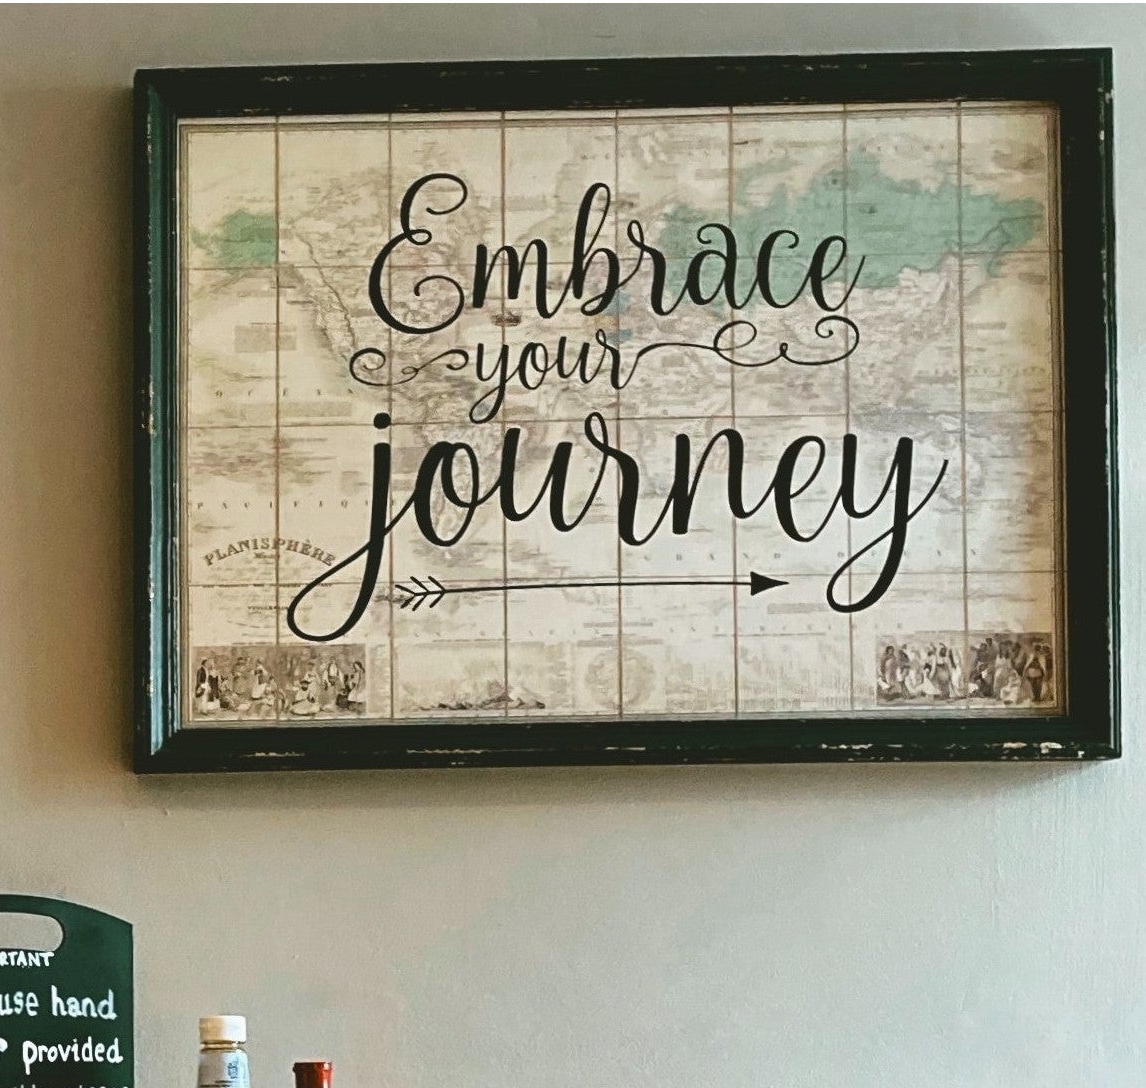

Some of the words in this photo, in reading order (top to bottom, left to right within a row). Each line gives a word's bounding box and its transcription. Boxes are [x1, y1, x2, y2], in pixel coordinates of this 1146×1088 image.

[367, 172, 866, 335] Embrace
[468, 329, 644, 424] your
[203, 537, 336, 567] PLANISPHÈRE
[286, 411, 949, 642] journey
[51, 984, 118, 1020] hand
[22, 1035, 124, 1075] provided
